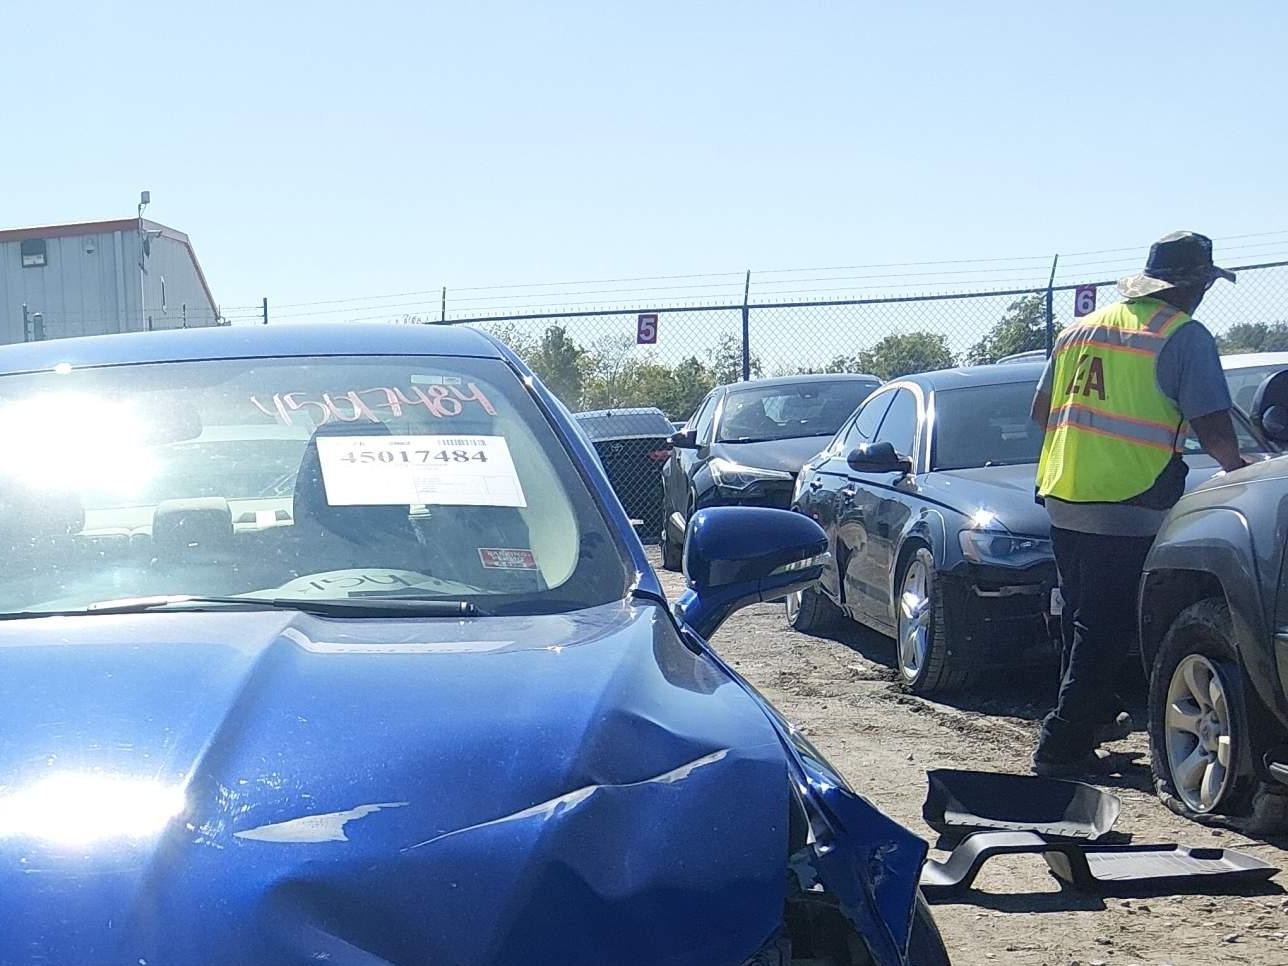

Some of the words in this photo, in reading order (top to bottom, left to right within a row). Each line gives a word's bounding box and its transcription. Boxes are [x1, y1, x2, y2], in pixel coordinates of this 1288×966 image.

[1077, 289, 1093, 314] 6
[639, 317, 656, 341] 5
[340, 449, 489, 464] 45017484
